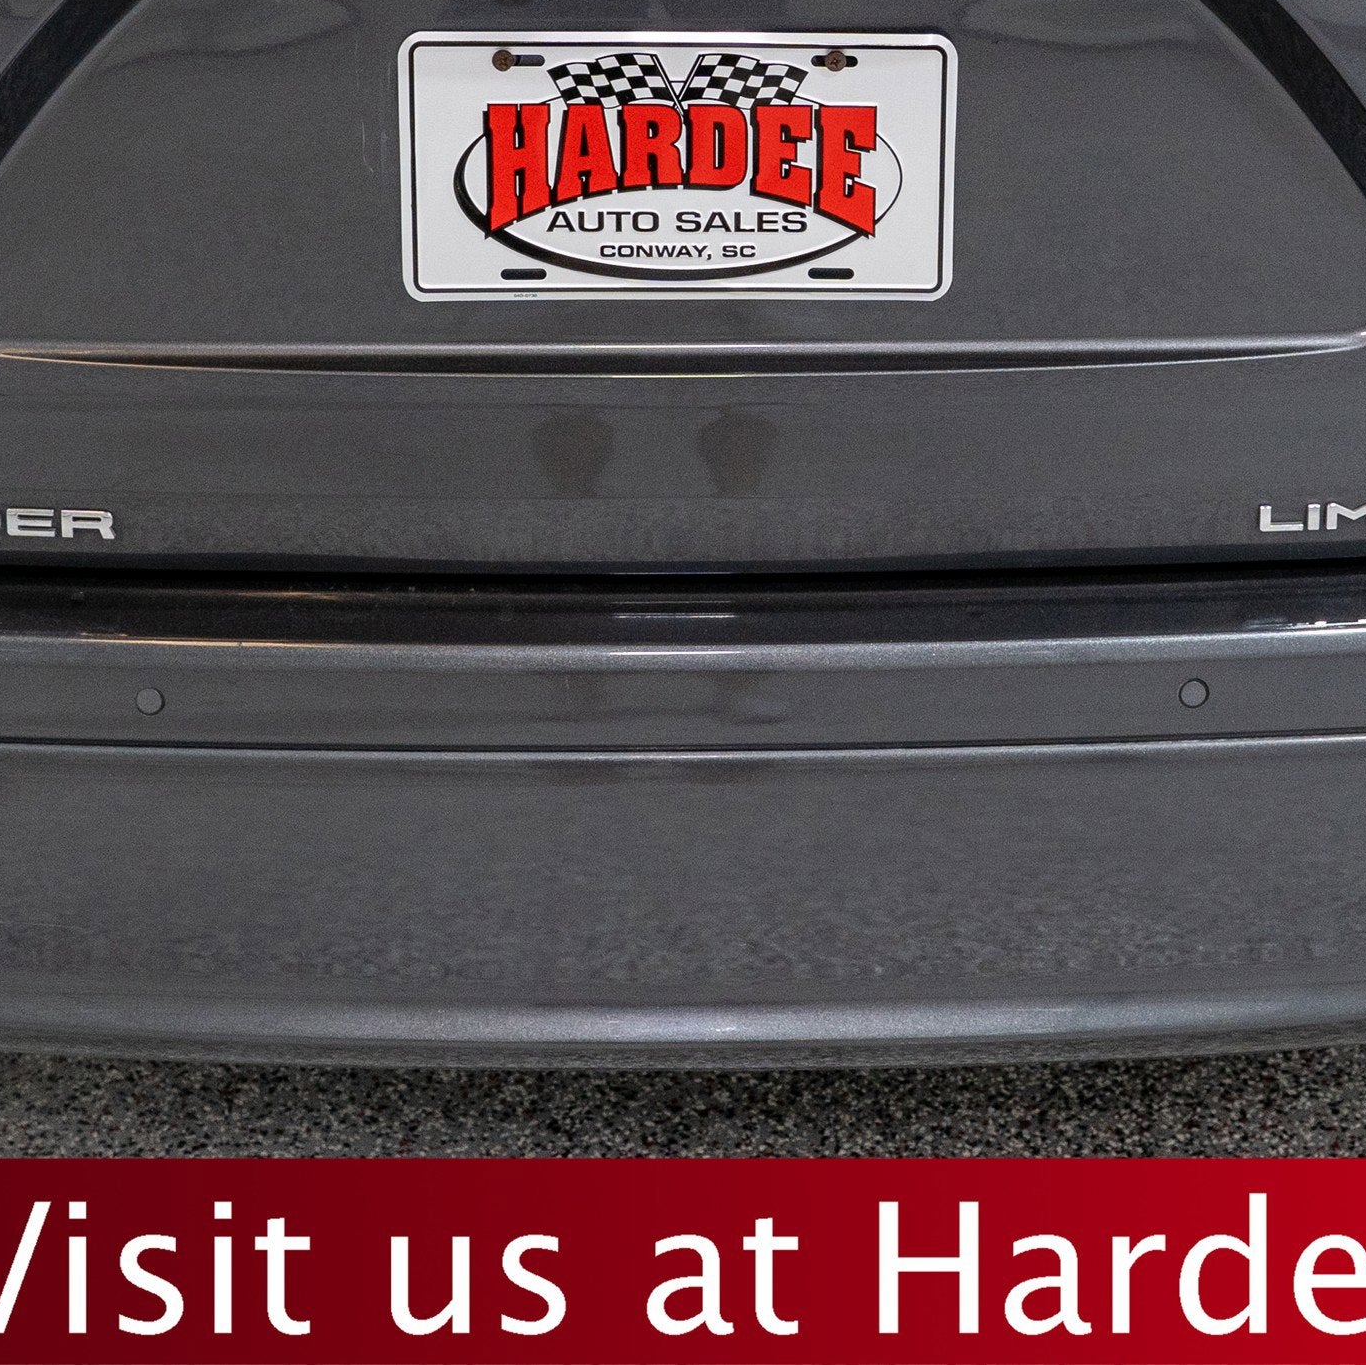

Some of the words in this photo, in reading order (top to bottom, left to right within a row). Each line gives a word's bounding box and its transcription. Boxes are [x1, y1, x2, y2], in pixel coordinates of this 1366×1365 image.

[484, 103, 878, 237] HARDEE
[546, 211, 660, 234] AUTO
[675, 211, 808, 234] SALES
[599, 245, 713, 261] CONWAY,
[722, 245, 757, 259] SC
